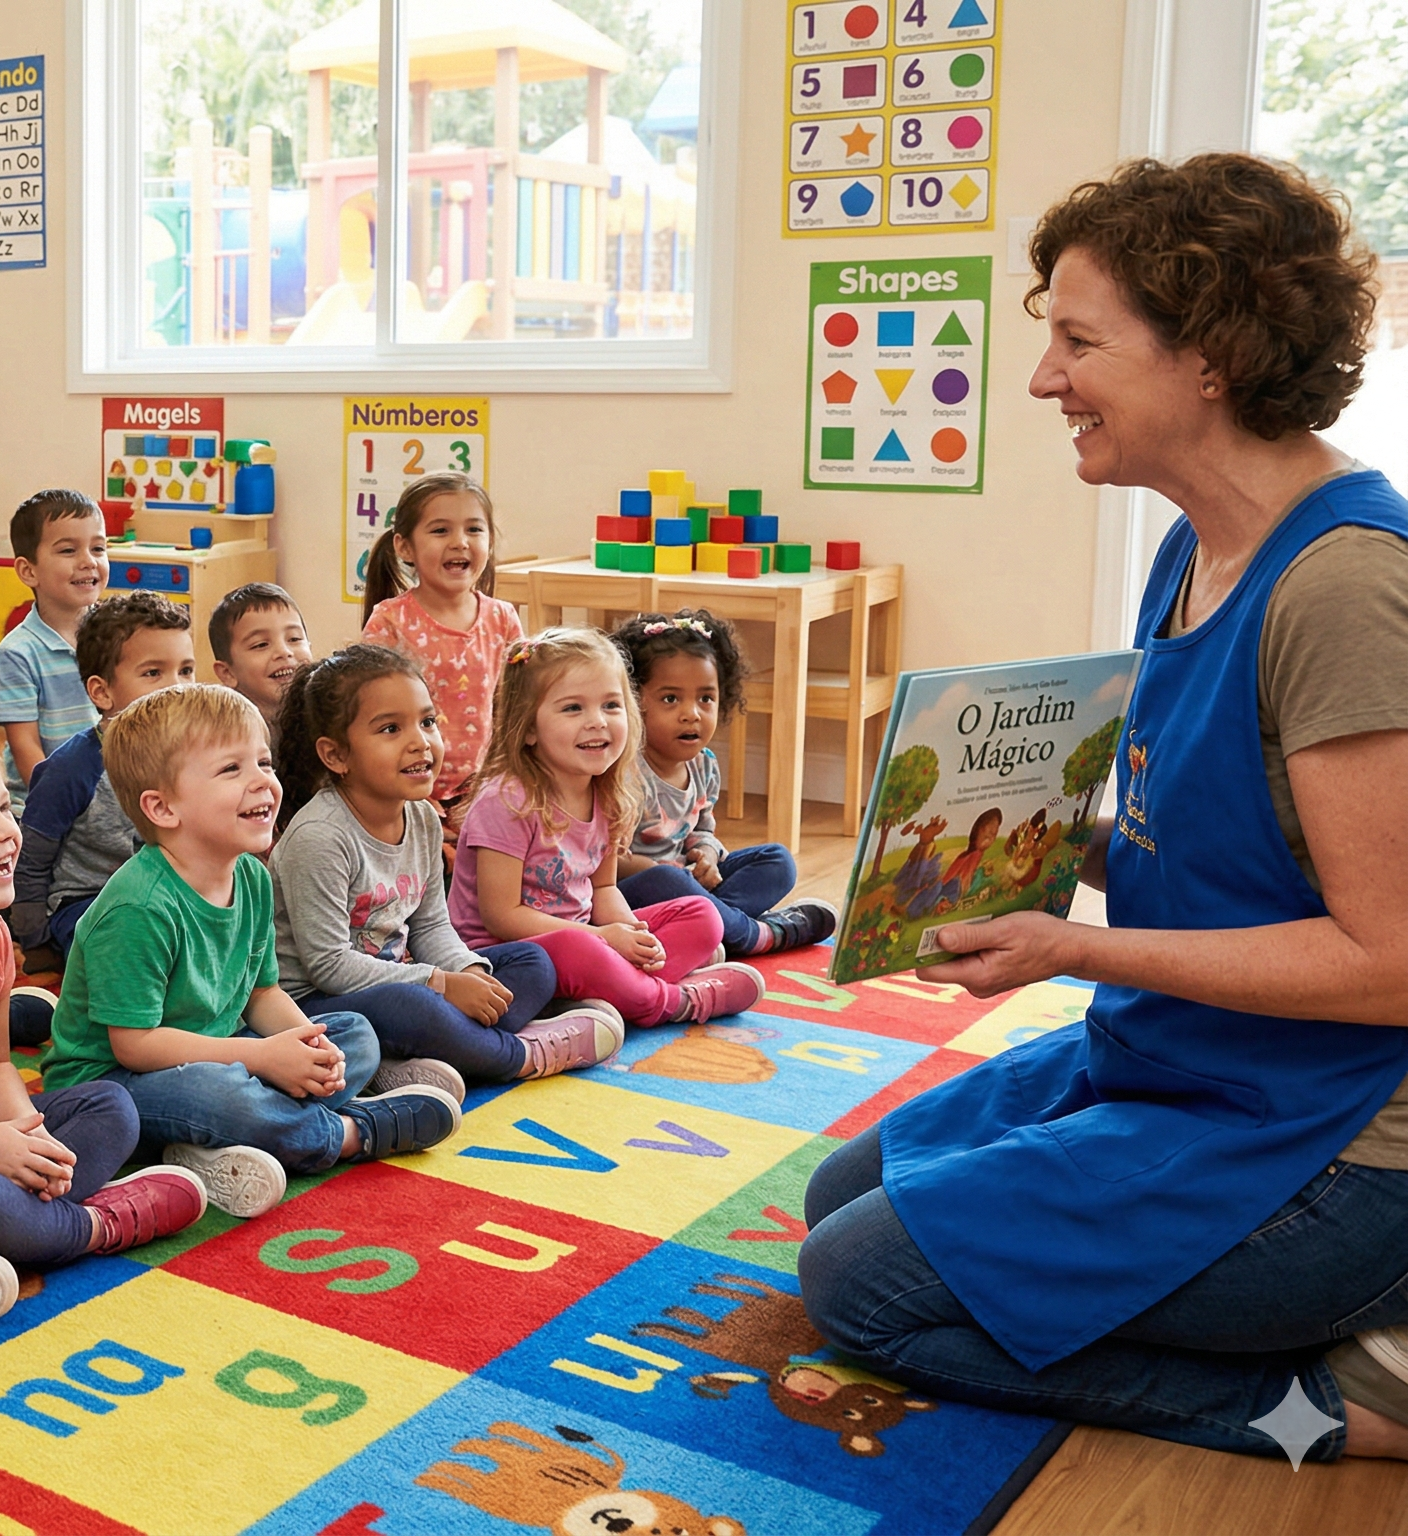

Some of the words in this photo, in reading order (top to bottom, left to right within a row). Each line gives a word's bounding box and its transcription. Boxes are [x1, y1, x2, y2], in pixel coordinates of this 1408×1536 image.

[803, 11, 815, 39] 1
[903, 0, 927, 28] 4
[800, 68, 821, 97] 5
[902, 58, 925, 88] 6
[16, 93, 39, 113] Dd
[799, 126, 820, 155] 7
[900, 118, 923, 148] 8
[17, 152, 39, 170] Oo
[20, 181, 40, 198] Rr
[797, 183, 818, 214] 9
[902, 177, 943, 208] 10
[18, 210, 39, 226] Xx
[838, 265, 958, 300] Shapes
[123, 402, 201, 430] Magels
[352, 402, 478, 427] Númberos
[362, 439, 373, 473] 1
[402, 439, 425, 475] 2
[448, 441, 471, 473] 3
[356, 492, 380, 526] 4
[957, 704, 982, 736] O
[986, 694, 1075, 738] Jardim
[957, 737, 1055, 777] Mágico
[457, 1118, 619, 1174] V
[623, 1120, 731, 1159] v
[258, 1228, 420, 1295] S
[214, 1350, 368, 1427] g
